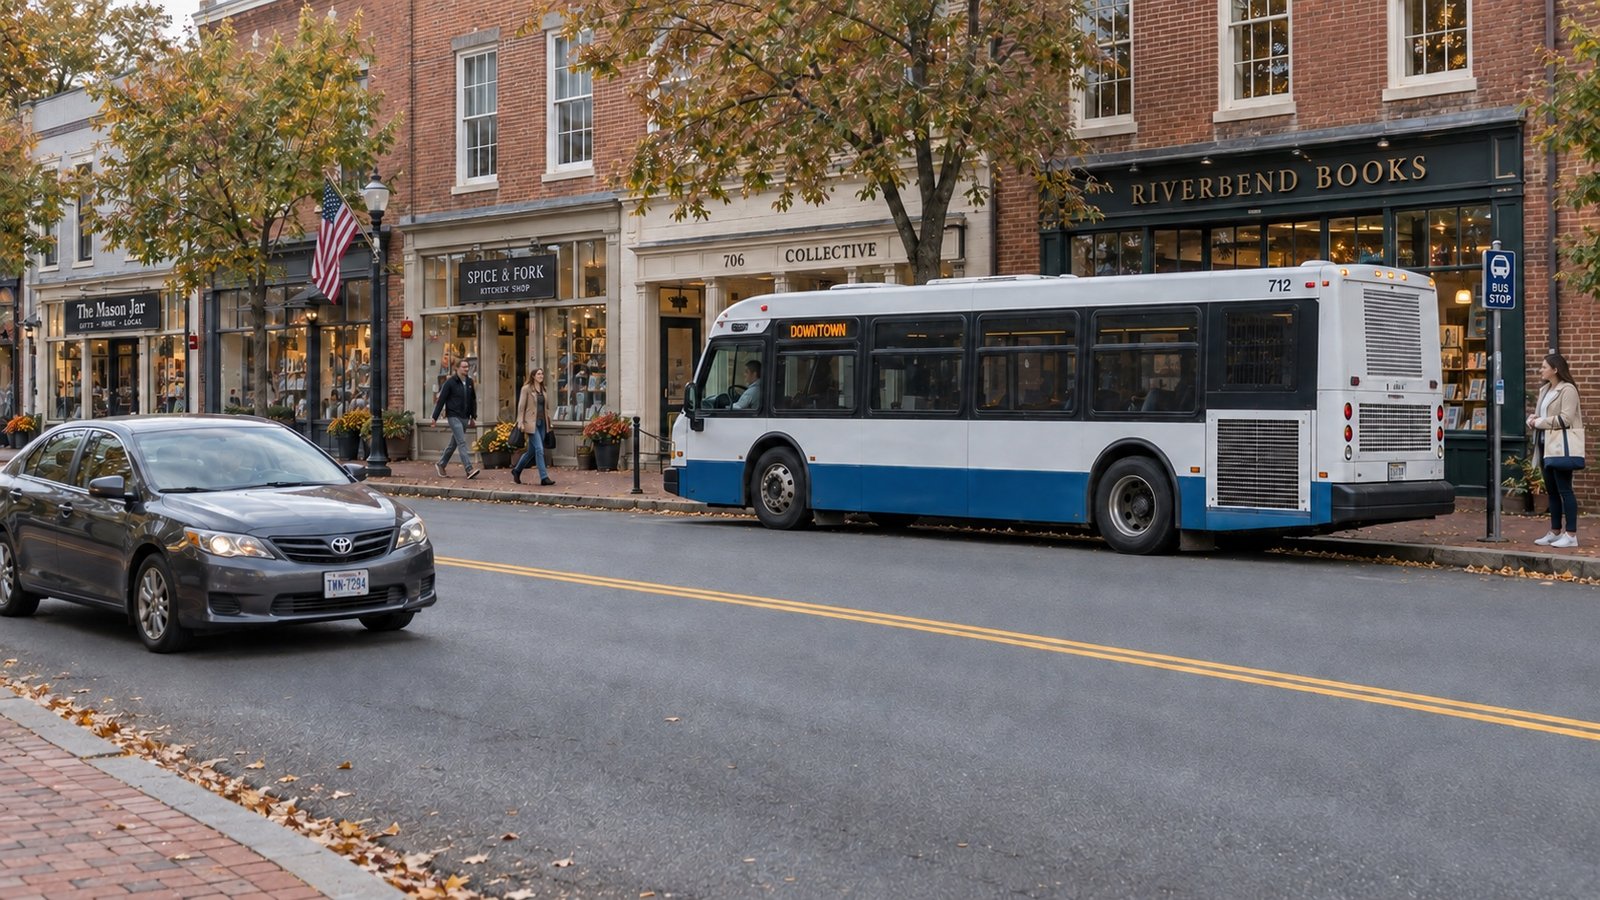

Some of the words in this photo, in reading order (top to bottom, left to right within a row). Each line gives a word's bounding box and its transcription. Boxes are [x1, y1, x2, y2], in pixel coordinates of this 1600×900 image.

[1131, 169, 1299, 205] RIVERBEND
[1315, 155, 1427, 189] BOOKS
[785, 242, 877, 263] COLLECTIVE
[723, 253, 745, 268] 706
[467, 269, 498, 284] SPICE
[501, 267, 510, 282] &
[513, 264, 544, 281] FORK
[512, 284, 531, 293] SHOP
[1268, 278, 1291, 292] 712
[1492, 283, 1509, 293] BUS
[1489, 294, 1512, 304] STOP
[76, 303, 94, 319] The
[95, 301, 127, 318] Mason
[129, 298, 146, 318] Jar
[123, 318, 142, 326] LOCAL
[790, 323, 846, 338] DOWNTOWN
